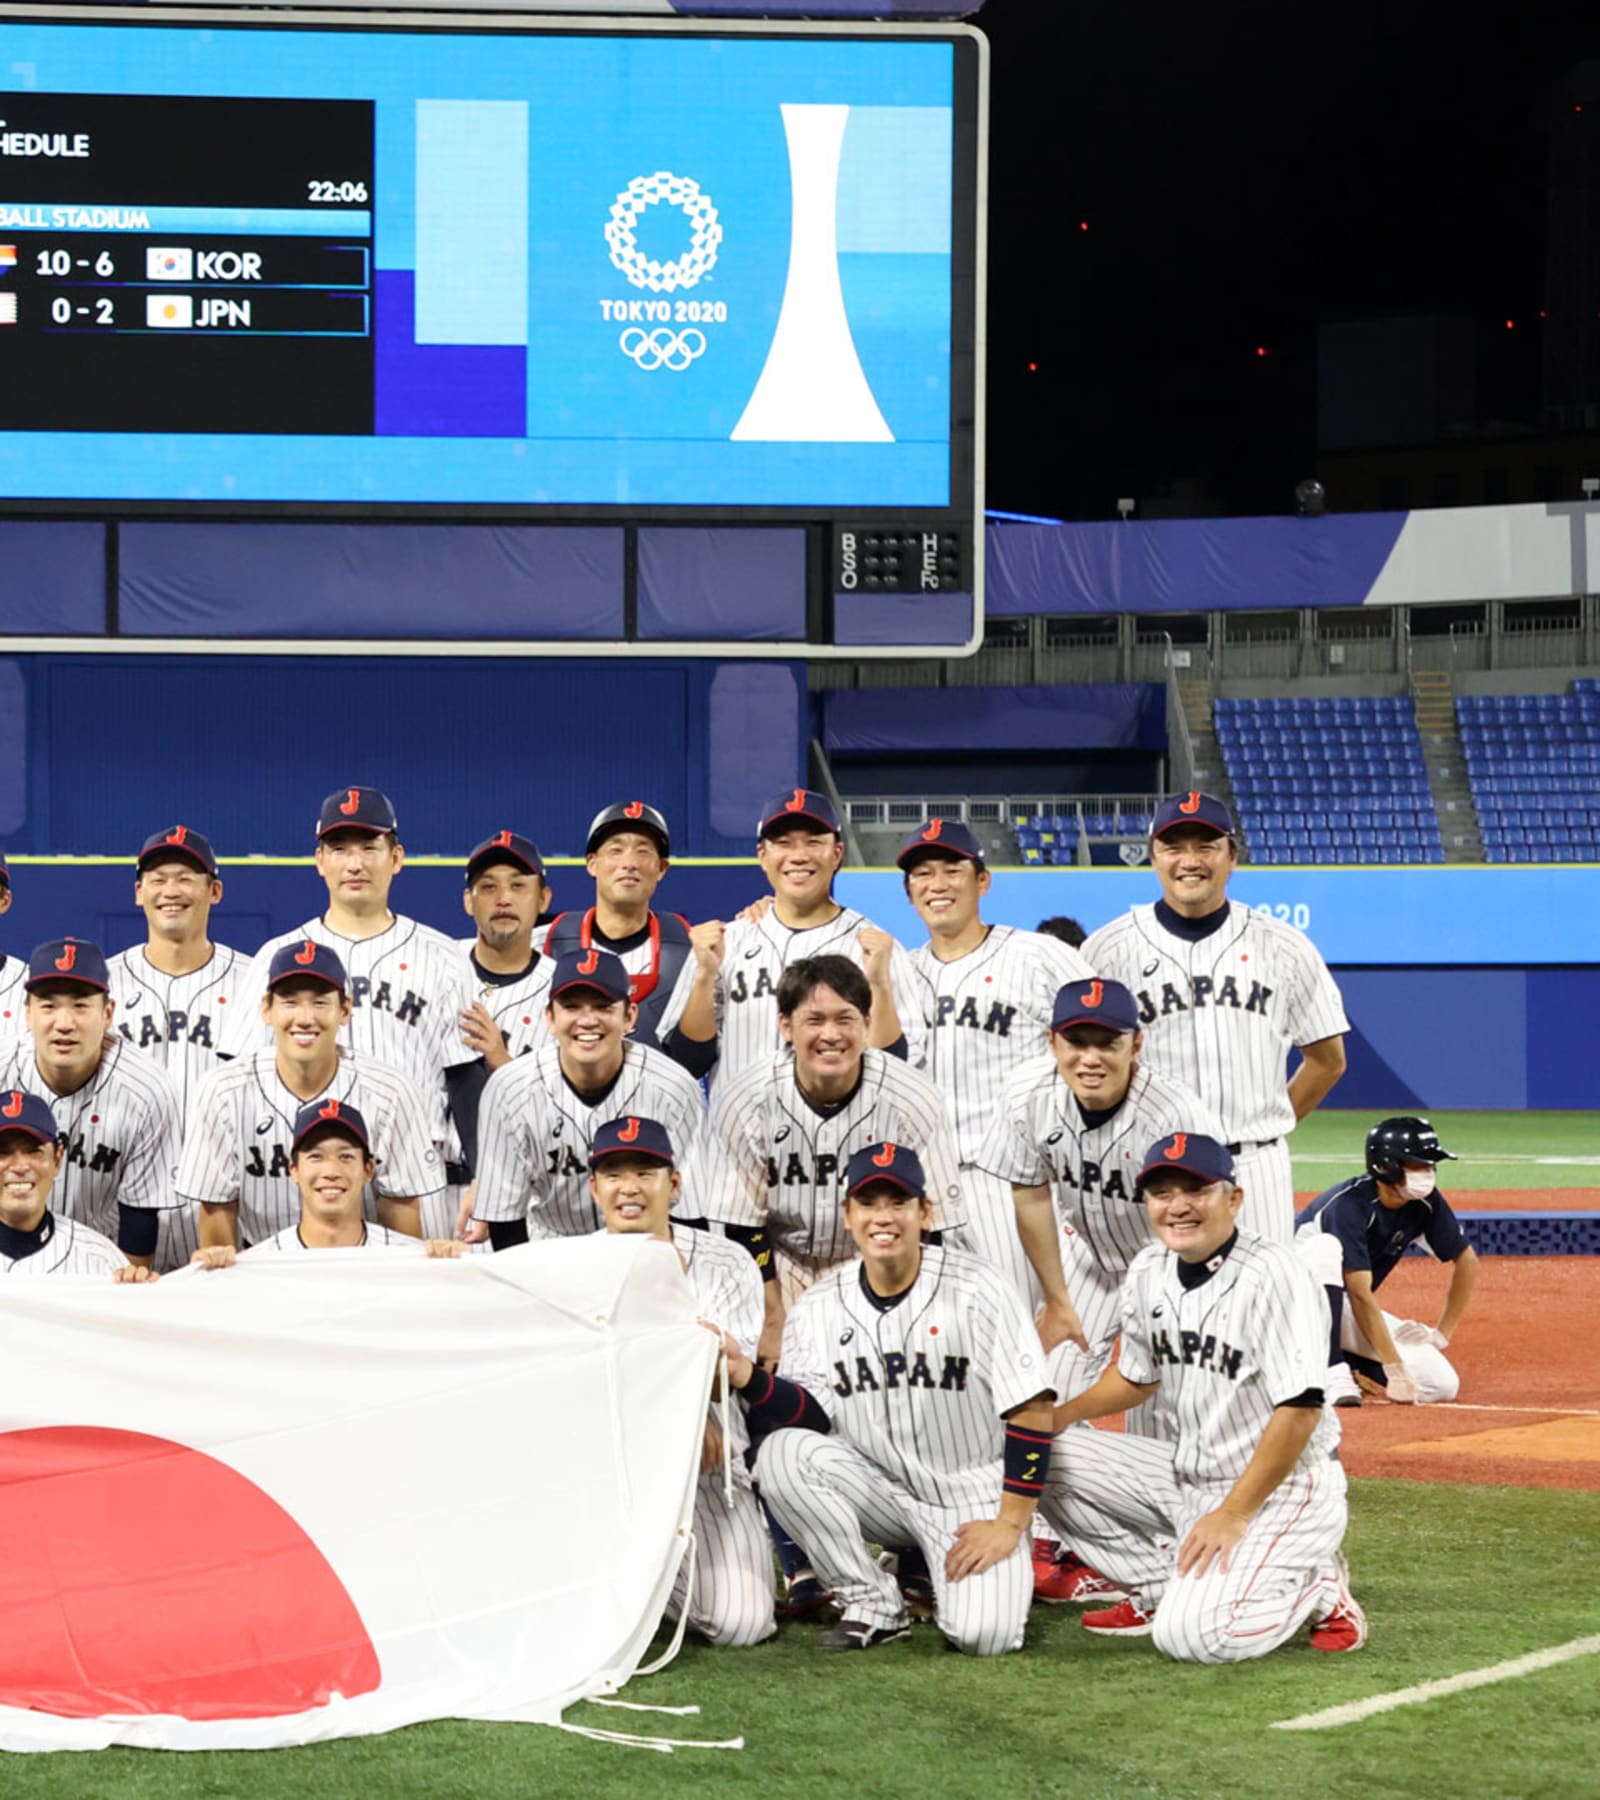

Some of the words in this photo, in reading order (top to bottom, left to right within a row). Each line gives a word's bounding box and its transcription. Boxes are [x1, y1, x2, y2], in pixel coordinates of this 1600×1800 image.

[309, 181, 368, 202] 22:06
[53, 208, 150, 229] STADIUM
[36, 250, 70, 276] 10
[96, 252, 114, 276] 6
[197, 252, 262, 280] KOR
[53, 298, 70, 324] 0
[95, 299, 114, 324] 2
[195, 300, 251, 327] JPN
[600, 300, 671, 322] TOKYO
[675, 302, 727, 323] 2020
[841, 533, 856, 551] B
[923, 533, 937, 551] H
[842, 552, 857, 571] S
[923, 551, 936, 570] E
[841, 570, 858, 589] O
[340, 790, 360, 816] J
[623, 801, 644, 819] J
[785, 789, 806, 813] J
[1180, 792, 1201, 814] J
[922, 819, 943, 842] J
[55, 945, 77, 971] J
[295, 942, 316, 965] J
[578, 950, 600, 975] J
[350, 976, 427, 1026] PAN
[1082, 981, 1104, 1008] J
[1137, 975, 1273, 1023] JAPAN
[925, 996, 1017, 1037] PAN
[3, 1092, 24, 1118] J
[617, 1118, 641, 1143] J
[872, 1142, 896, 1168] J
[1163, 1134, 1188, 1160] J
[833, 1352, 970, 1398] JAPAN
